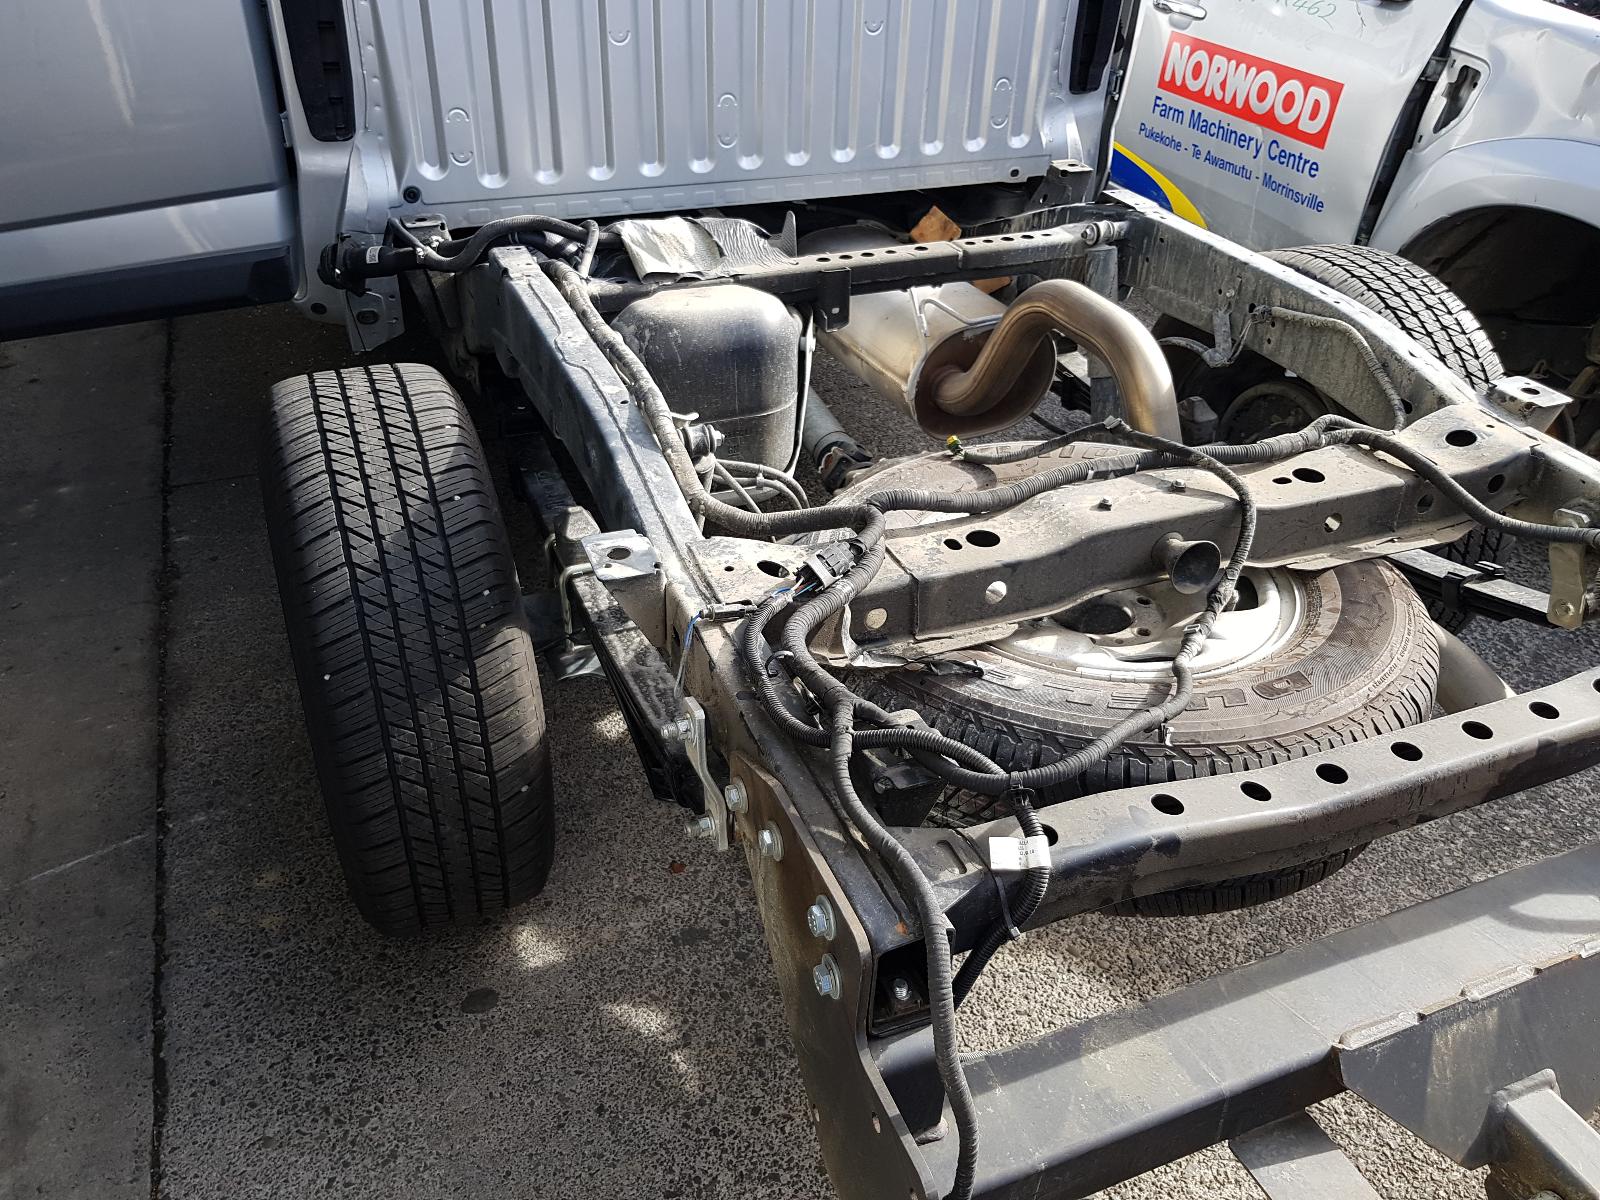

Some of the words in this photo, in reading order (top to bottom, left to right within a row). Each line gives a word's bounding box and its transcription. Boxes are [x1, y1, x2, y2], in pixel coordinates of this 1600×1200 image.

[1164, 42, 1331, 135] NORWOOD
[1138, 123, 1182, 152] Pukekohe
[1191, 144, 1201, 161] Te
[1203, 150, 1253, 181] Awamutu
[1262, 173, 1325, 213] Morrinsville
[1152, 96, 1185, 125] Farm
[1188, 109, 1263, 159] Machinery
[1267, 140, 1320, 179] Centre
